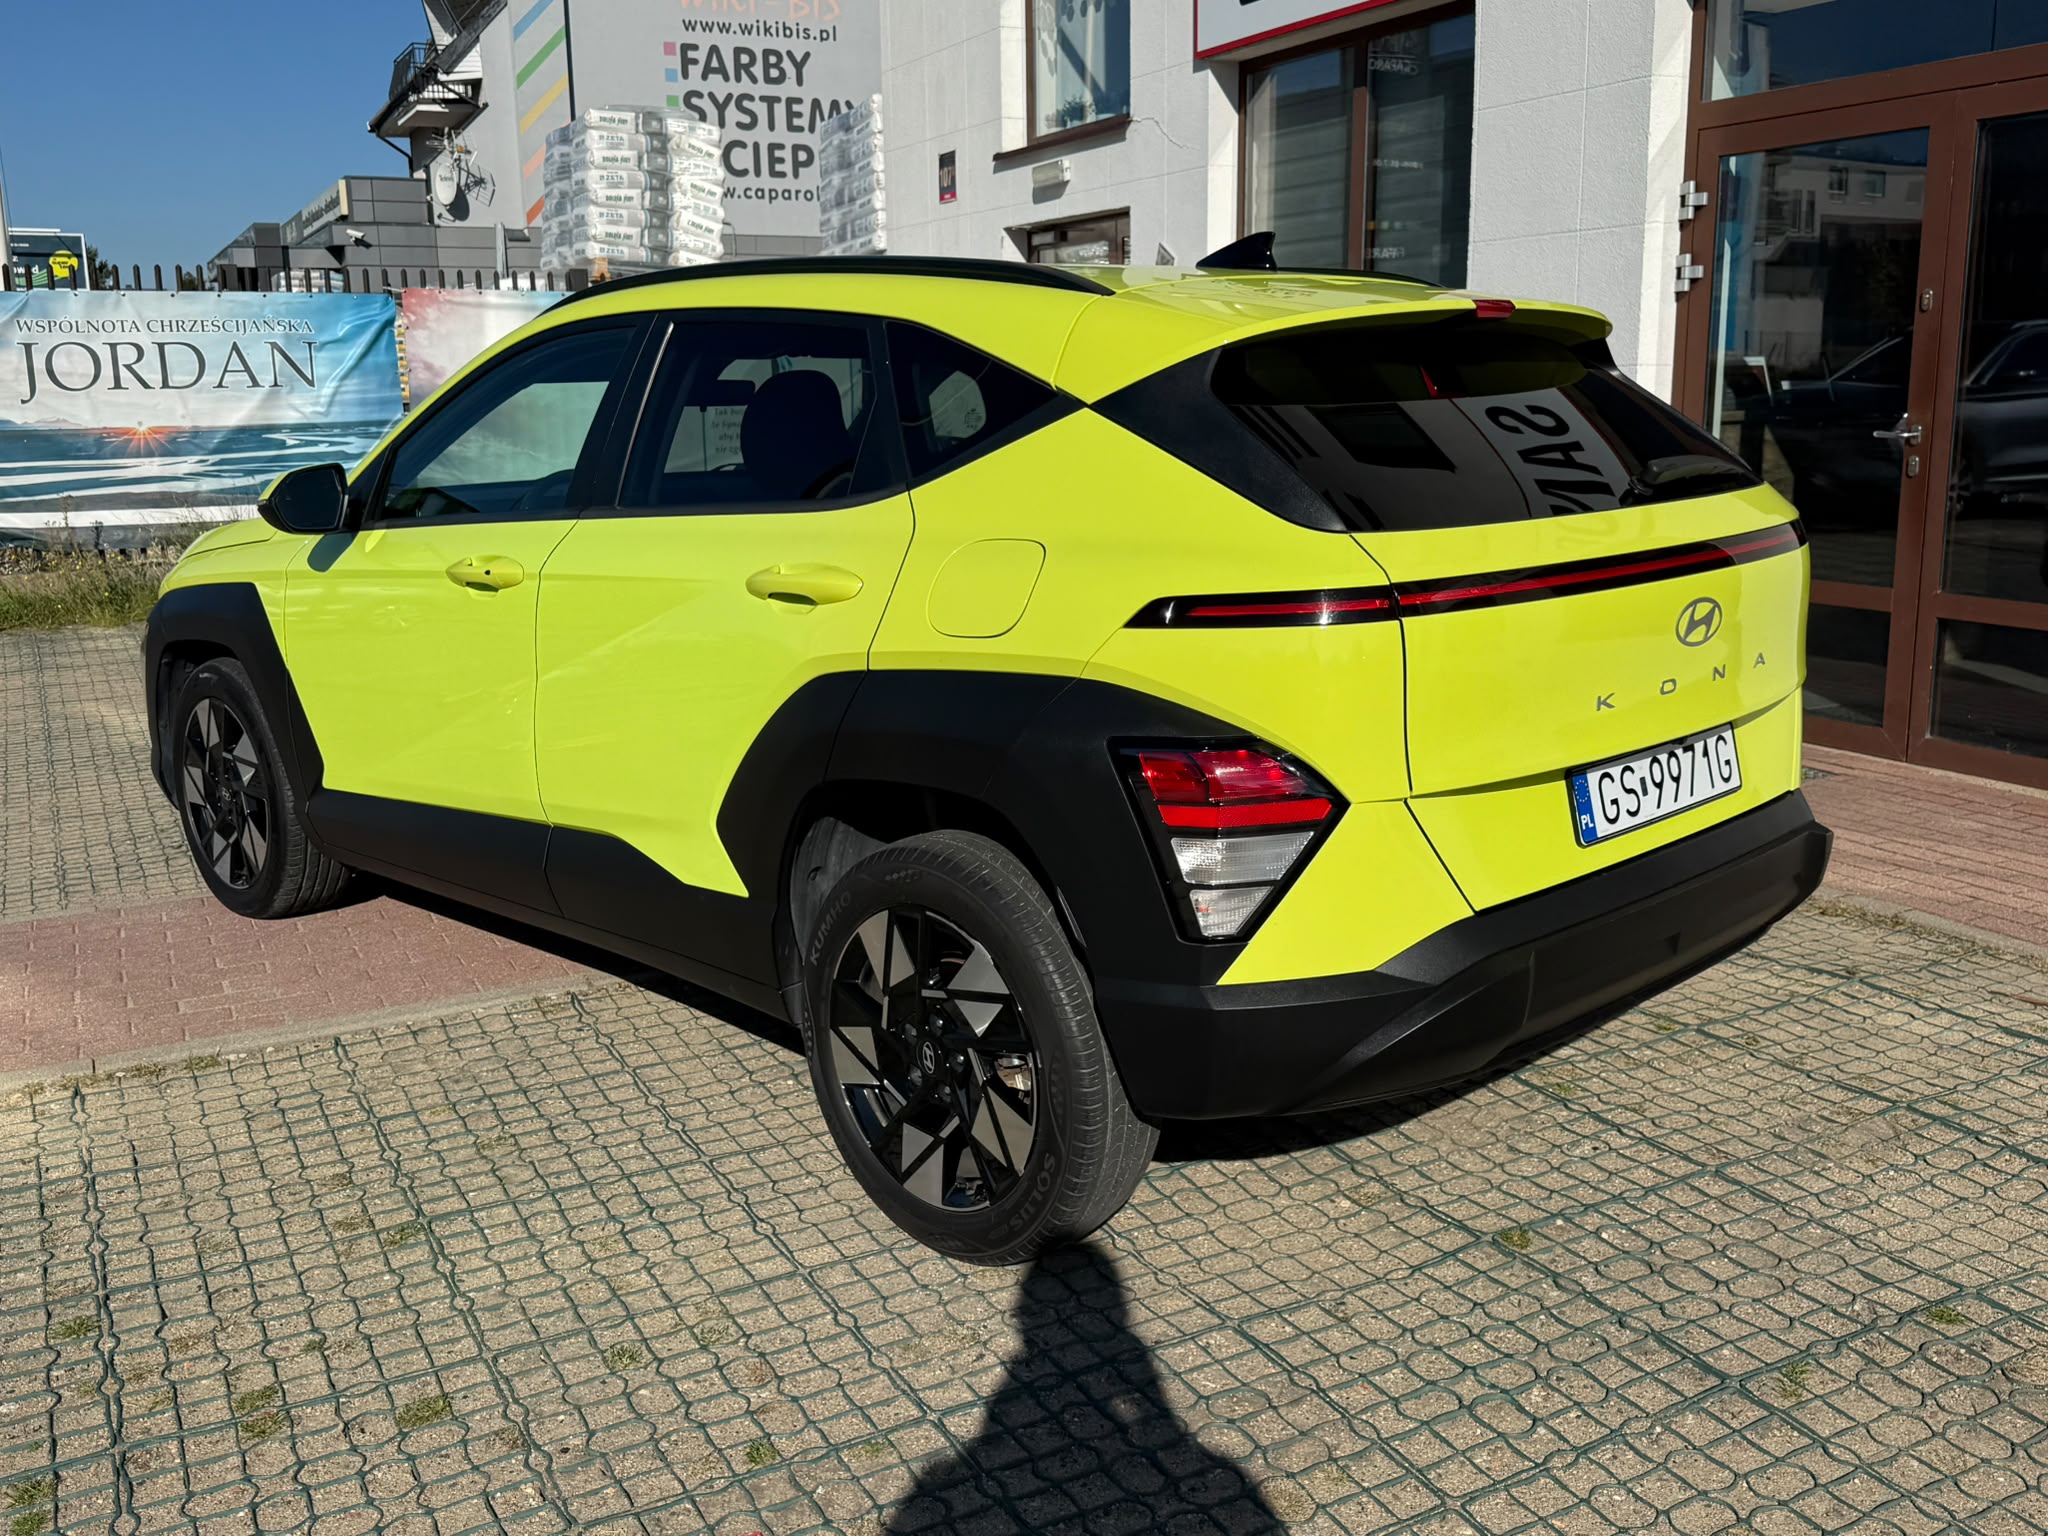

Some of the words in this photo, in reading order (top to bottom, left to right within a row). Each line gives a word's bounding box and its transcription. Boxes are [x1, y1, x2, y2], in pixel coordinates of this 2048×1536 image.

[682, 19, 837, 42] www.wikibis.pl
[680, 43, 811, 87] FARBY
[683, 90, 856, 134] SYSTEM
[16, 316, 141, 334] WSPÓLNOTA
[147, 315, 314, 335] CHRZEŚCIJAŃSKA
[16, 341, 318, 405] JORDAN
[1596, 652, 1766, 711] KONA
[1581, 814, 1594, 830] PL
[810, 890, 851, 967] KUMHO
[1009, 1153, 1056, 1231] SOLUS
